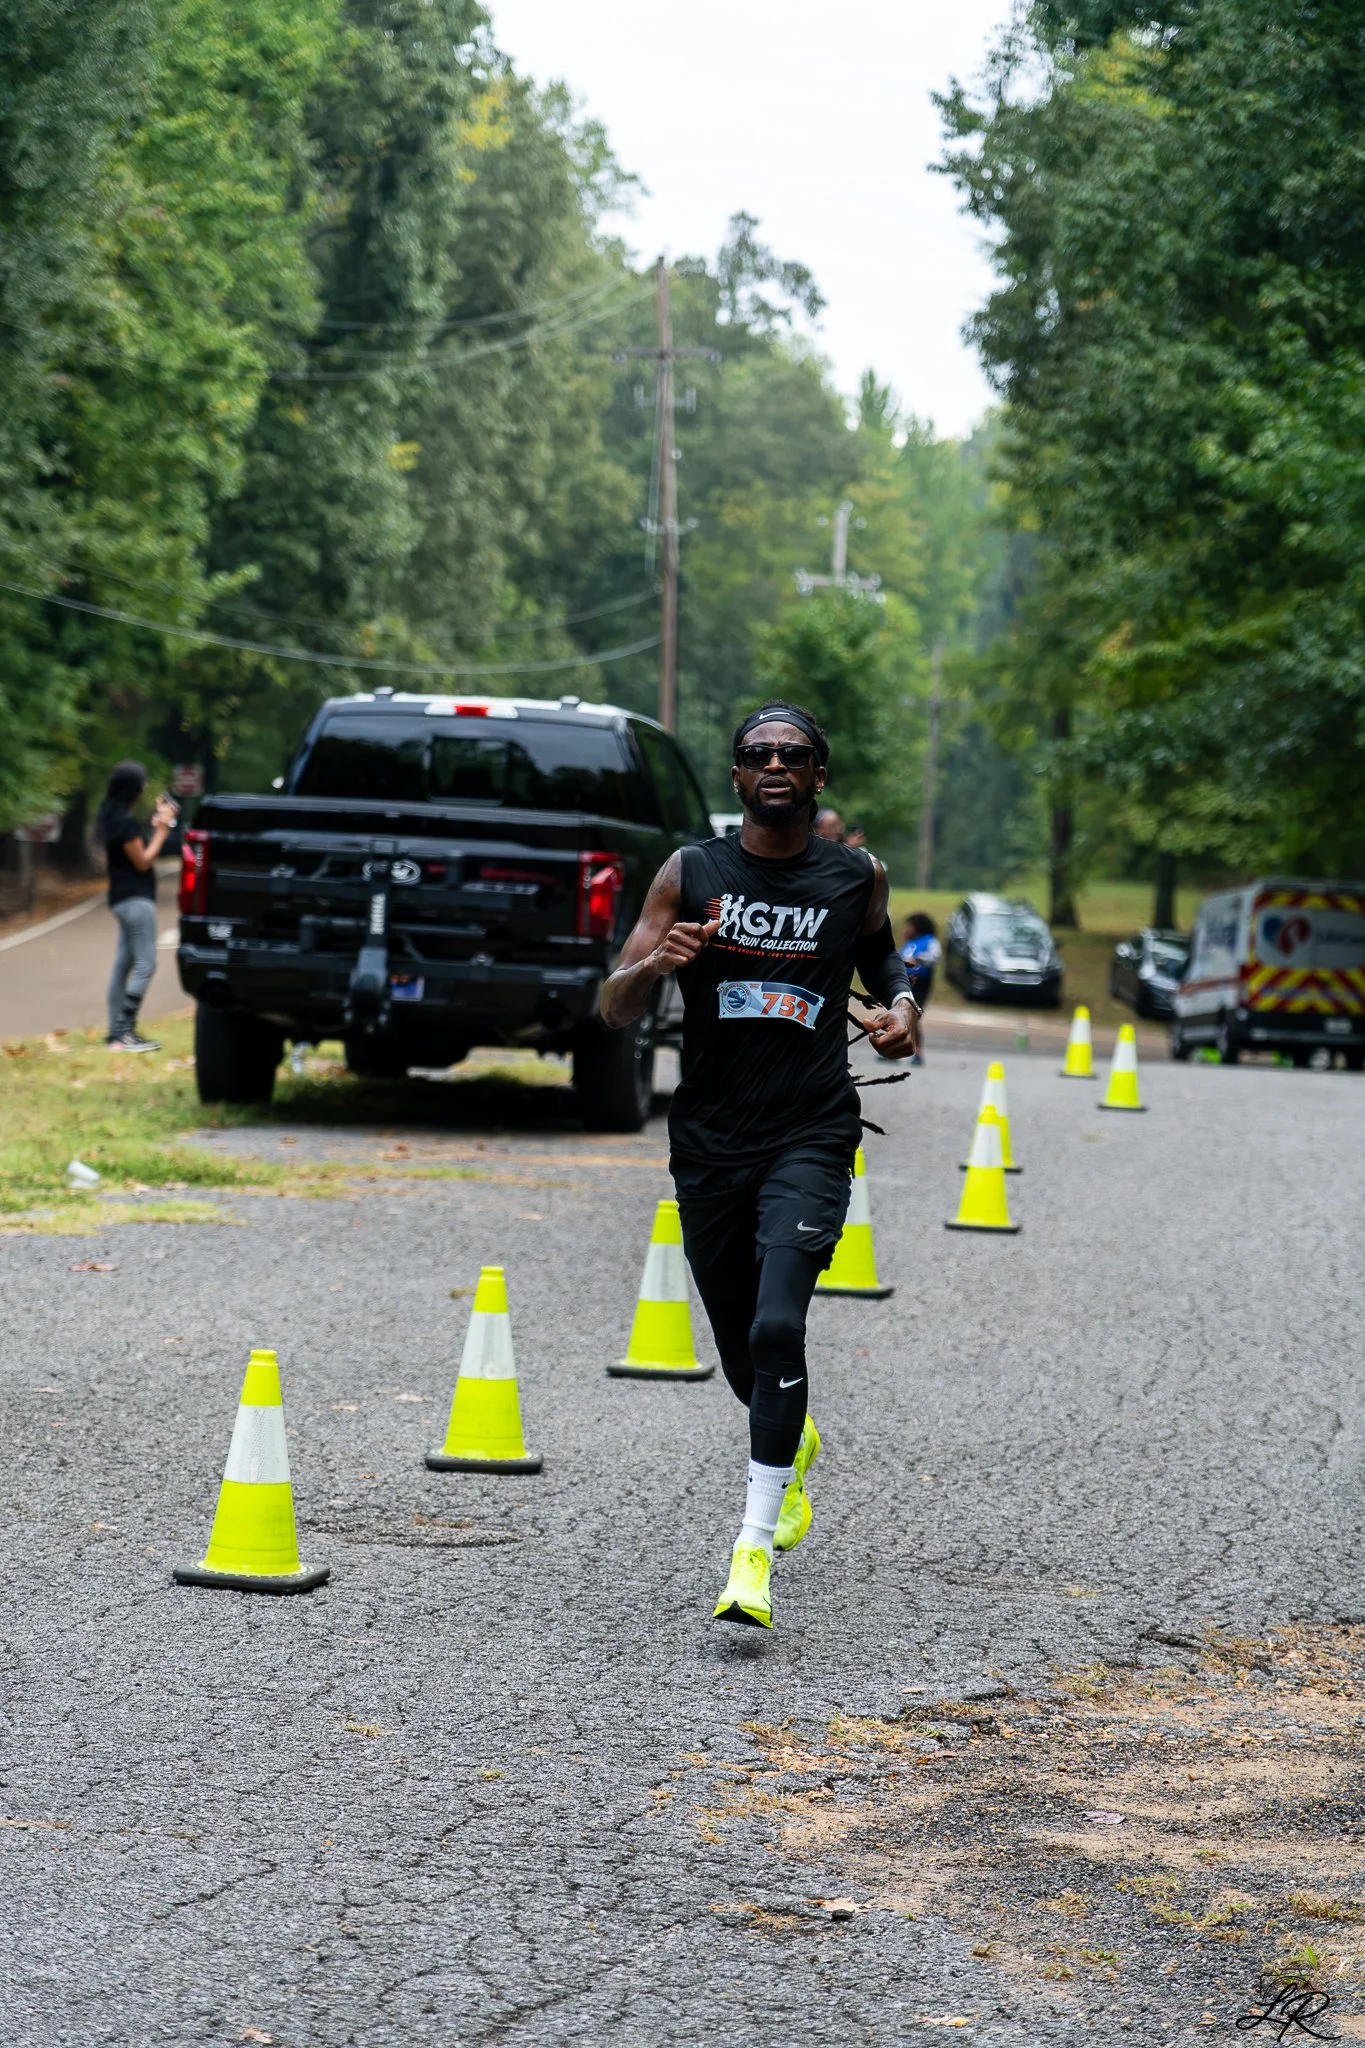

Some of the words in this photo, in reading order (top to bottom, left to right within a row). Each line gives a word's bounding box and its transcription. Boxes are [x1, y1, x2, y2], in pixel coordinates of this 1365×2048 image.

[742, 902, 829, 939] GTW
[738, 934, 758, 947] RUN
[761, 938, 818, 952] COLLECTION
[761, 993, 809, 1025] 752
